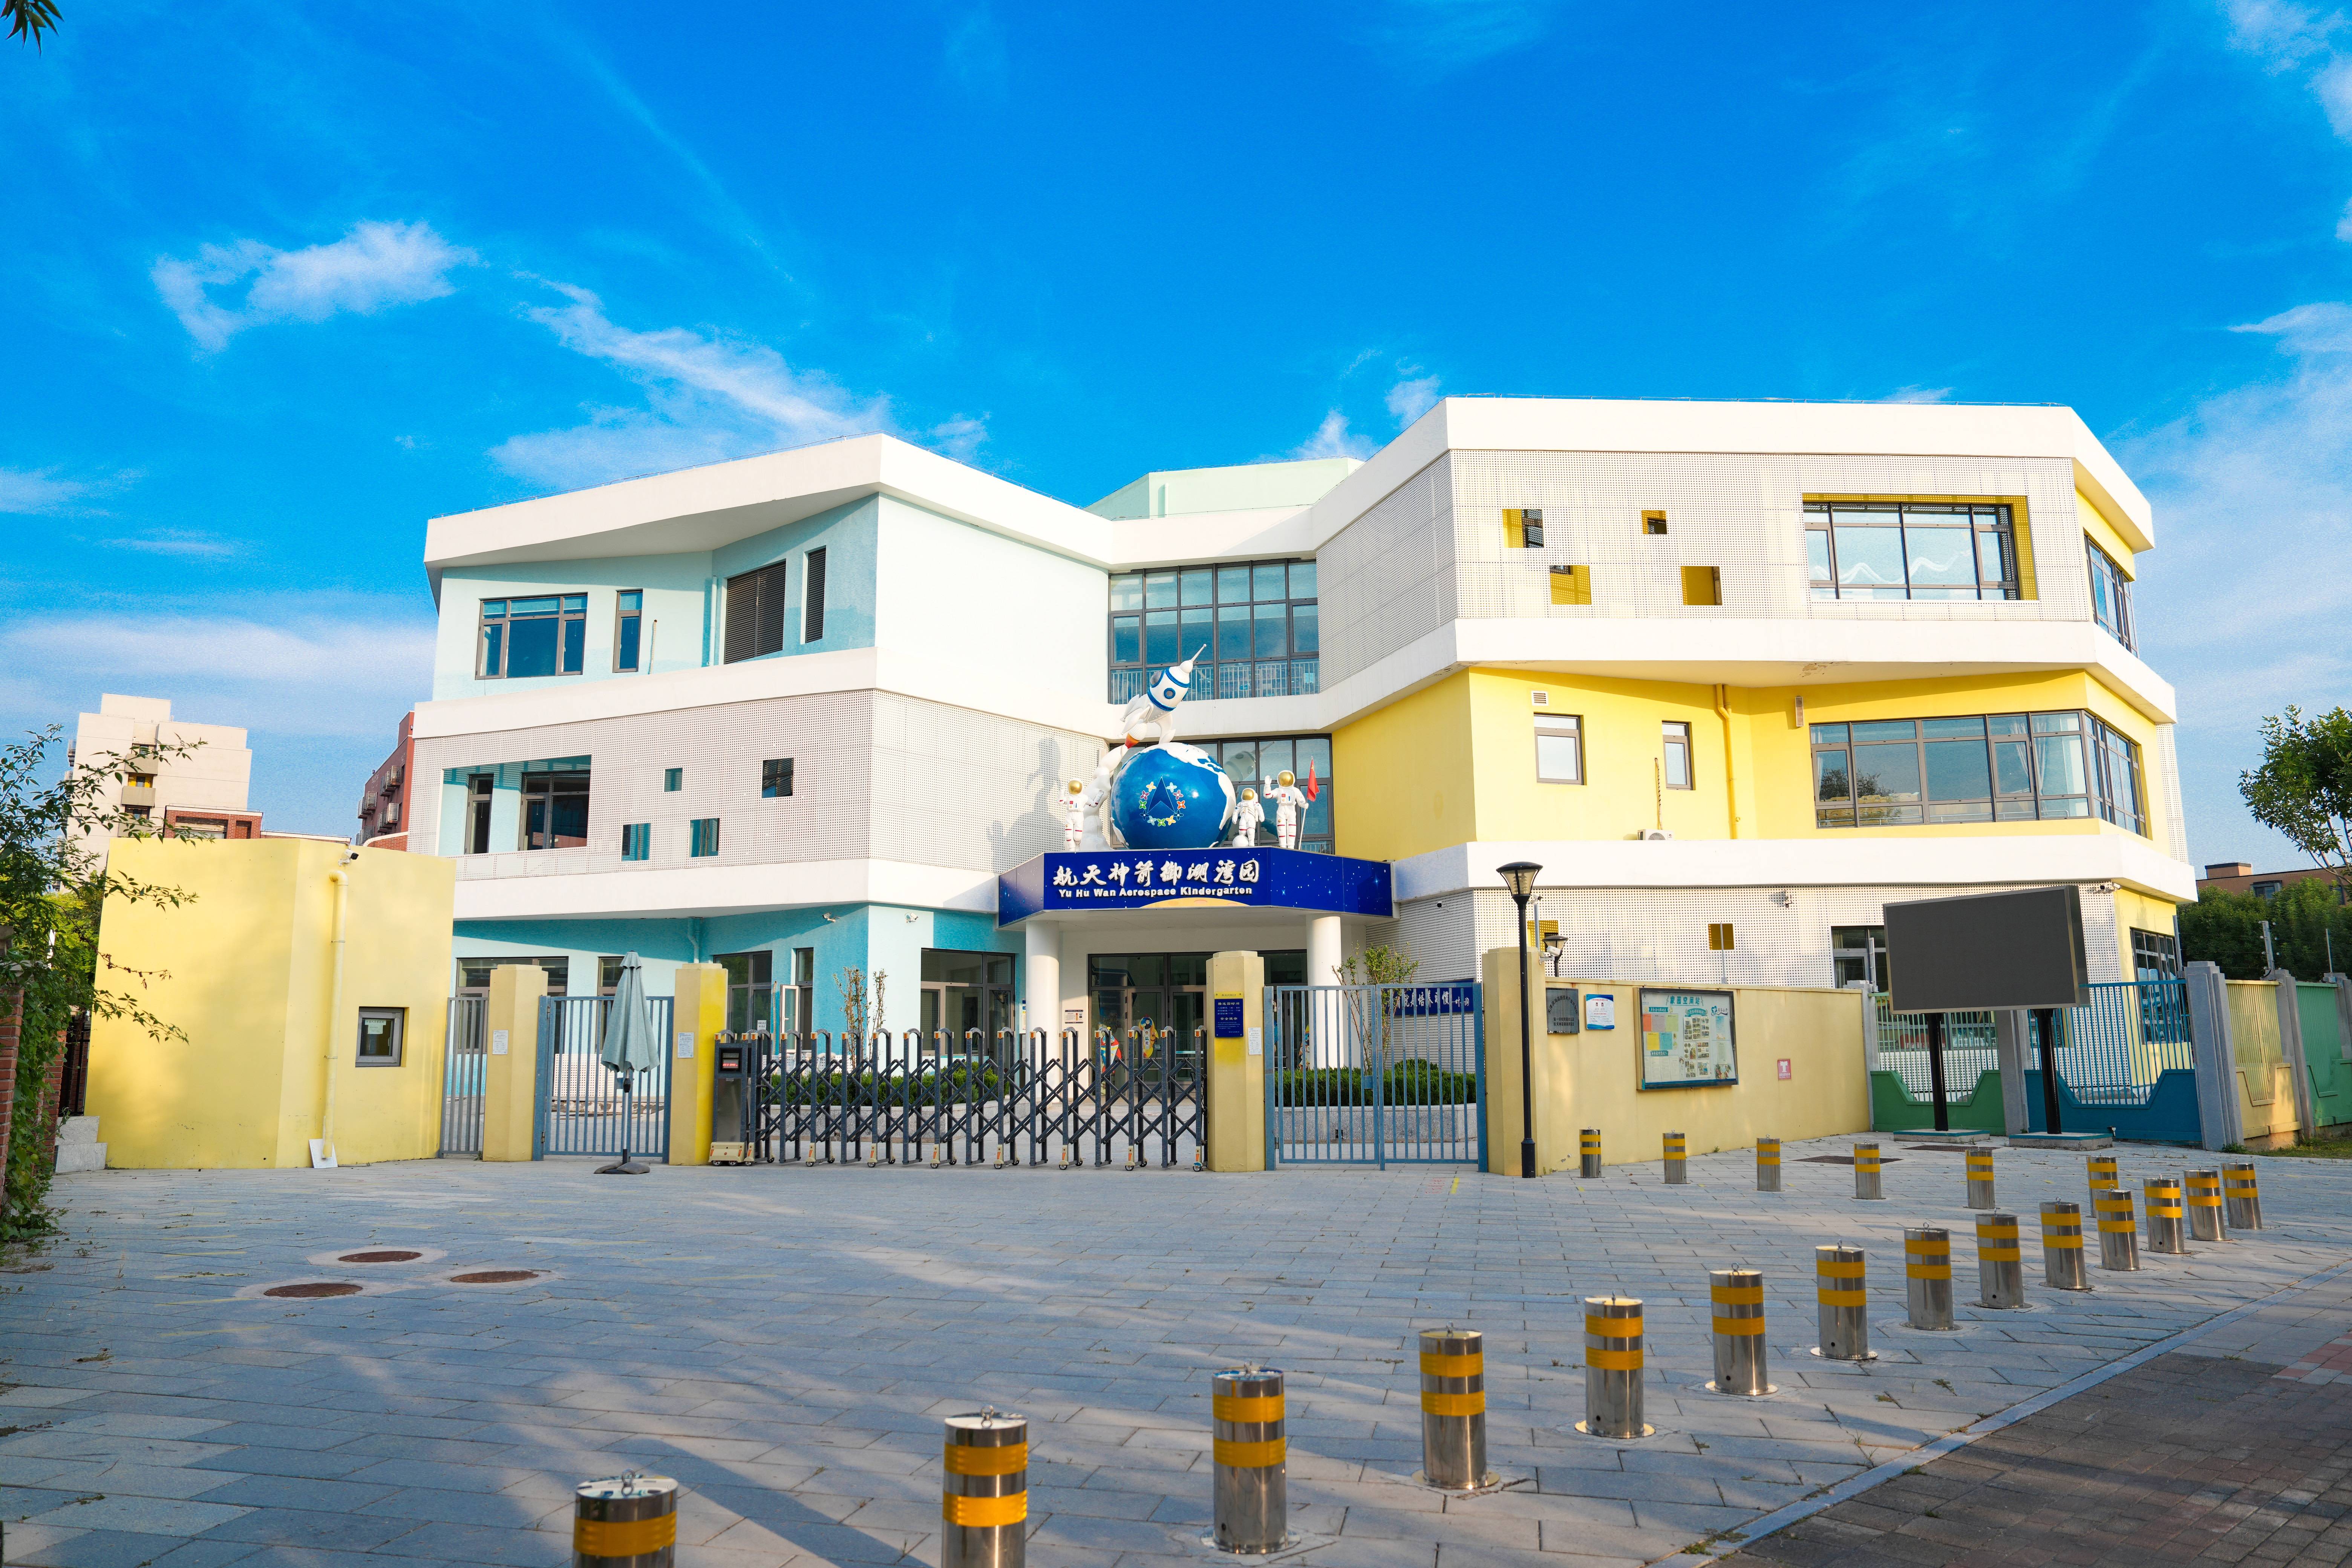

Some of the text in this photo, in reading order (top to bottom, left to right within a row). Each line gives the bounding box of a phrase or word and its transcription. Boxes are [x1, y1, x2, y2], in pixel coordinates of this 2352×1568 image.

[1053, 860, 1259, 887] 航天神箭御湖湾园
[1058, 887, 1252, 897] Yu Hu Wan Aerospace Kindergarten
